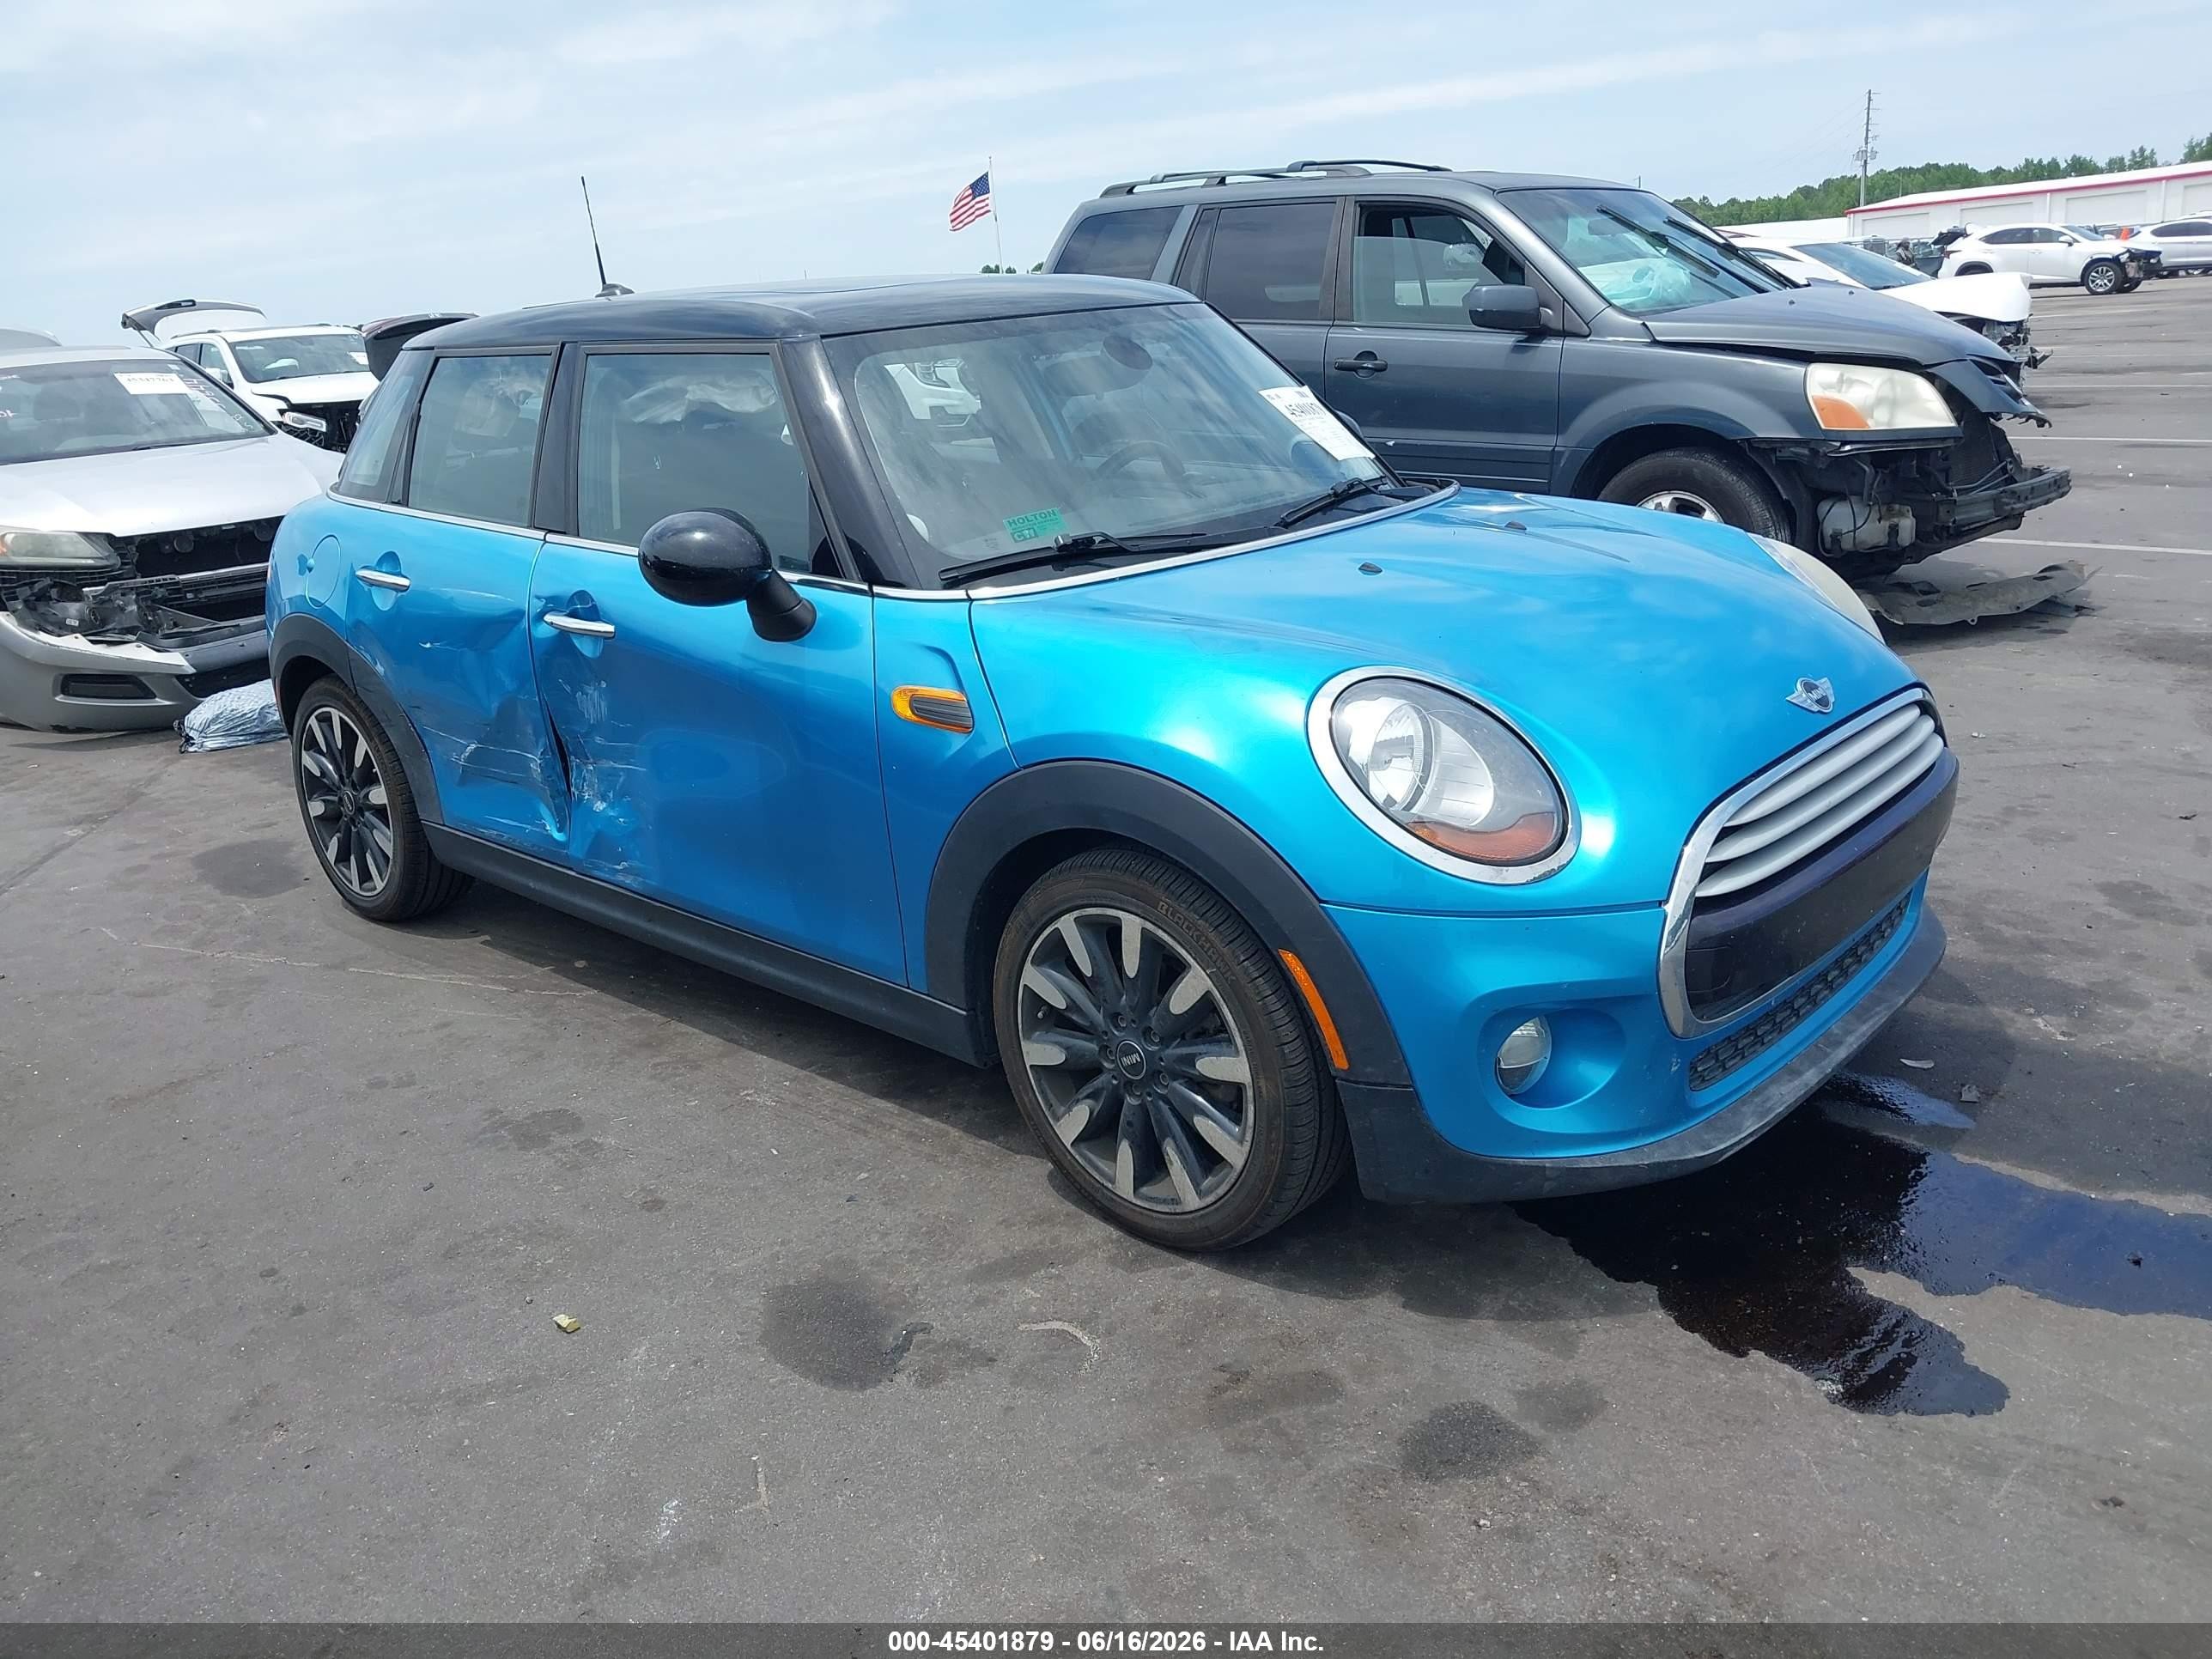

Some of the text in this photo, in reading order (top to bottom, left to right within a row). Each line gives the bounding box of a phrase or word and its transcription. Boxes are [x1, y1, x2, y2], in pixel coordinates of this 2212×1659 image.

[1006, 509, 1057, 527] HOLTON
[1807, 687, 1827, 701] MINI
[1121, 1052, 1141, 1066] MINI
